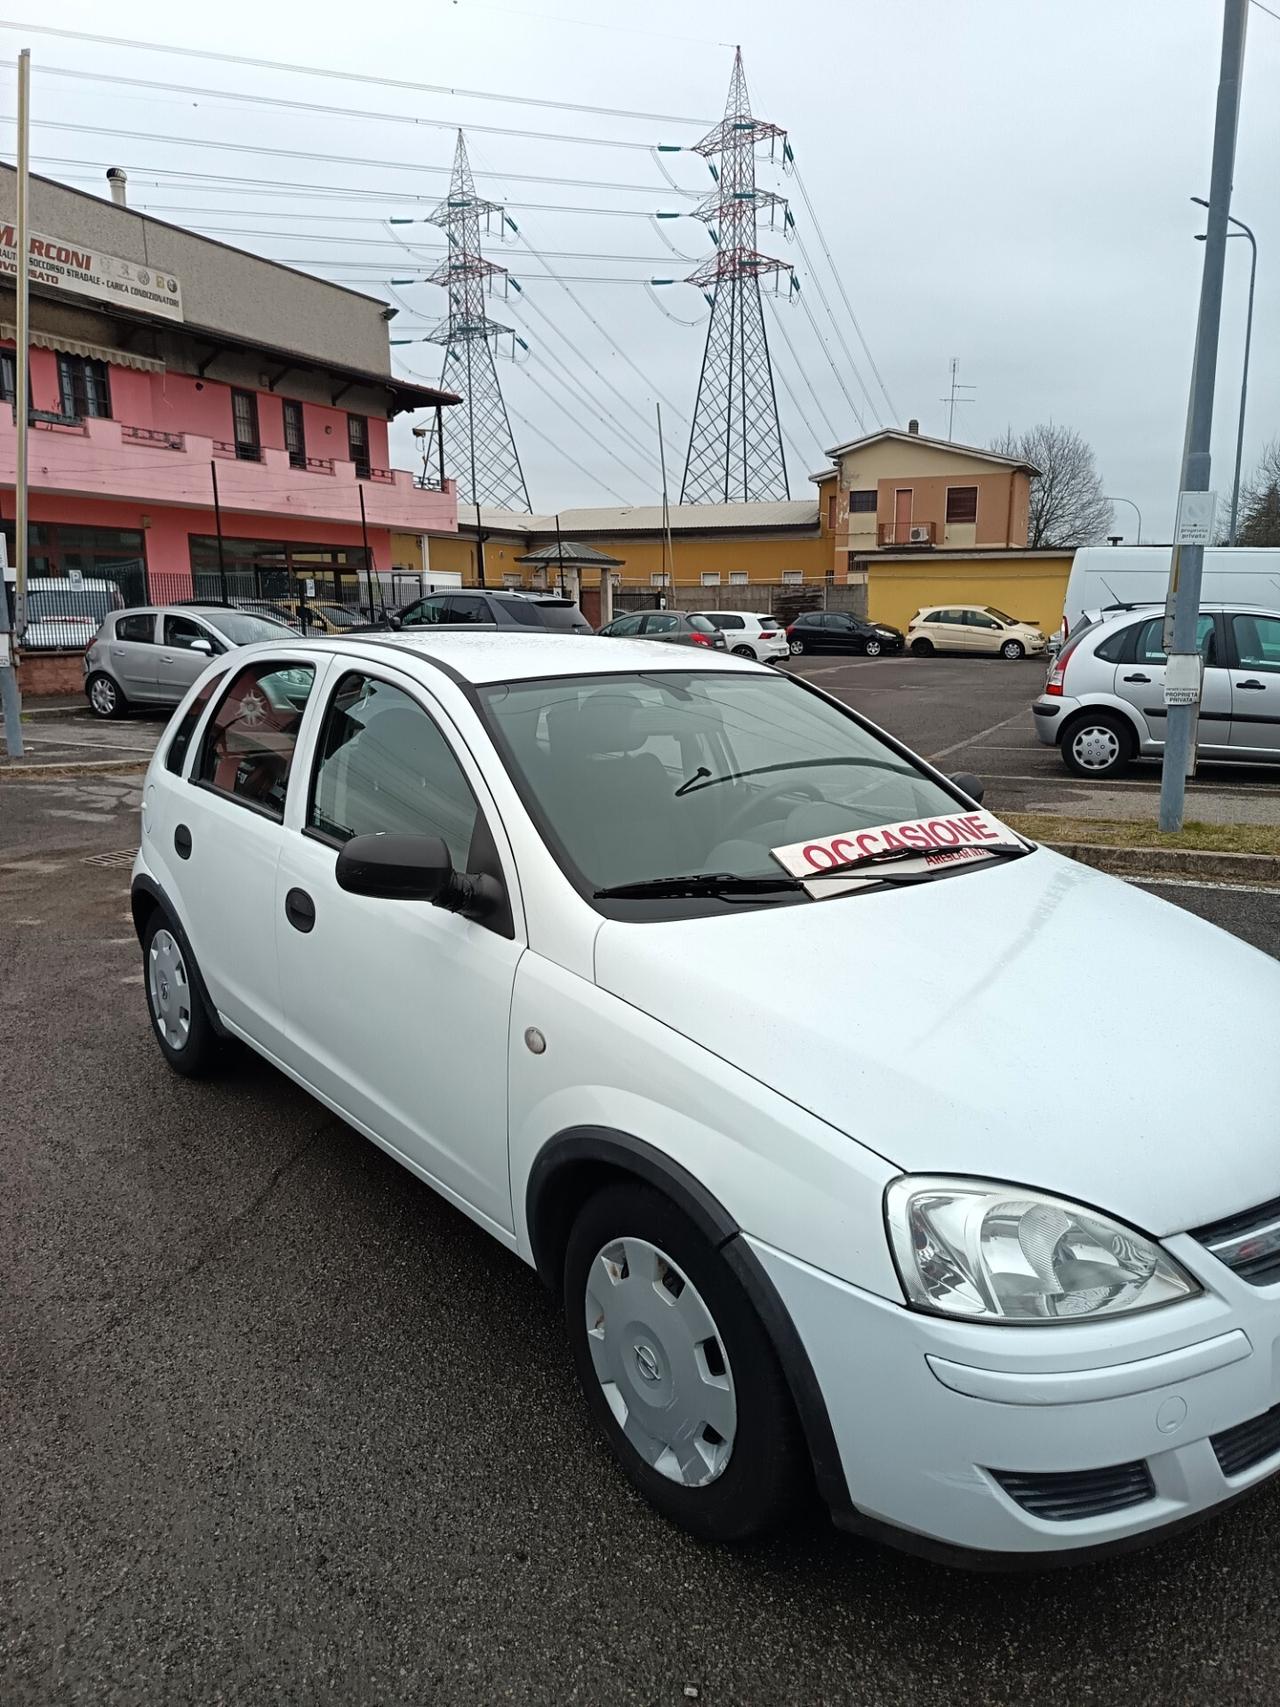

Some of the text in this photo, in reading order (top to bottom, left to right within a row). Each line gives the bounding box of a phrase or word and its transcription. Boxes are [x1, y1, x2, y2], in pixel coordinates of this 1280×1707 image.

[0, 226, 91, 270] MRCONI
[28, 256, 65, 276] SOCCORSO
[66, 267, 101, 286] STRADALE
[106, 279, 129, 294] CARICA
[130, 287, 180, 307] CONDIZIONATORI
[73, 572, 80, 583] P
[802, 815, 999, 871] OCCASIONE
